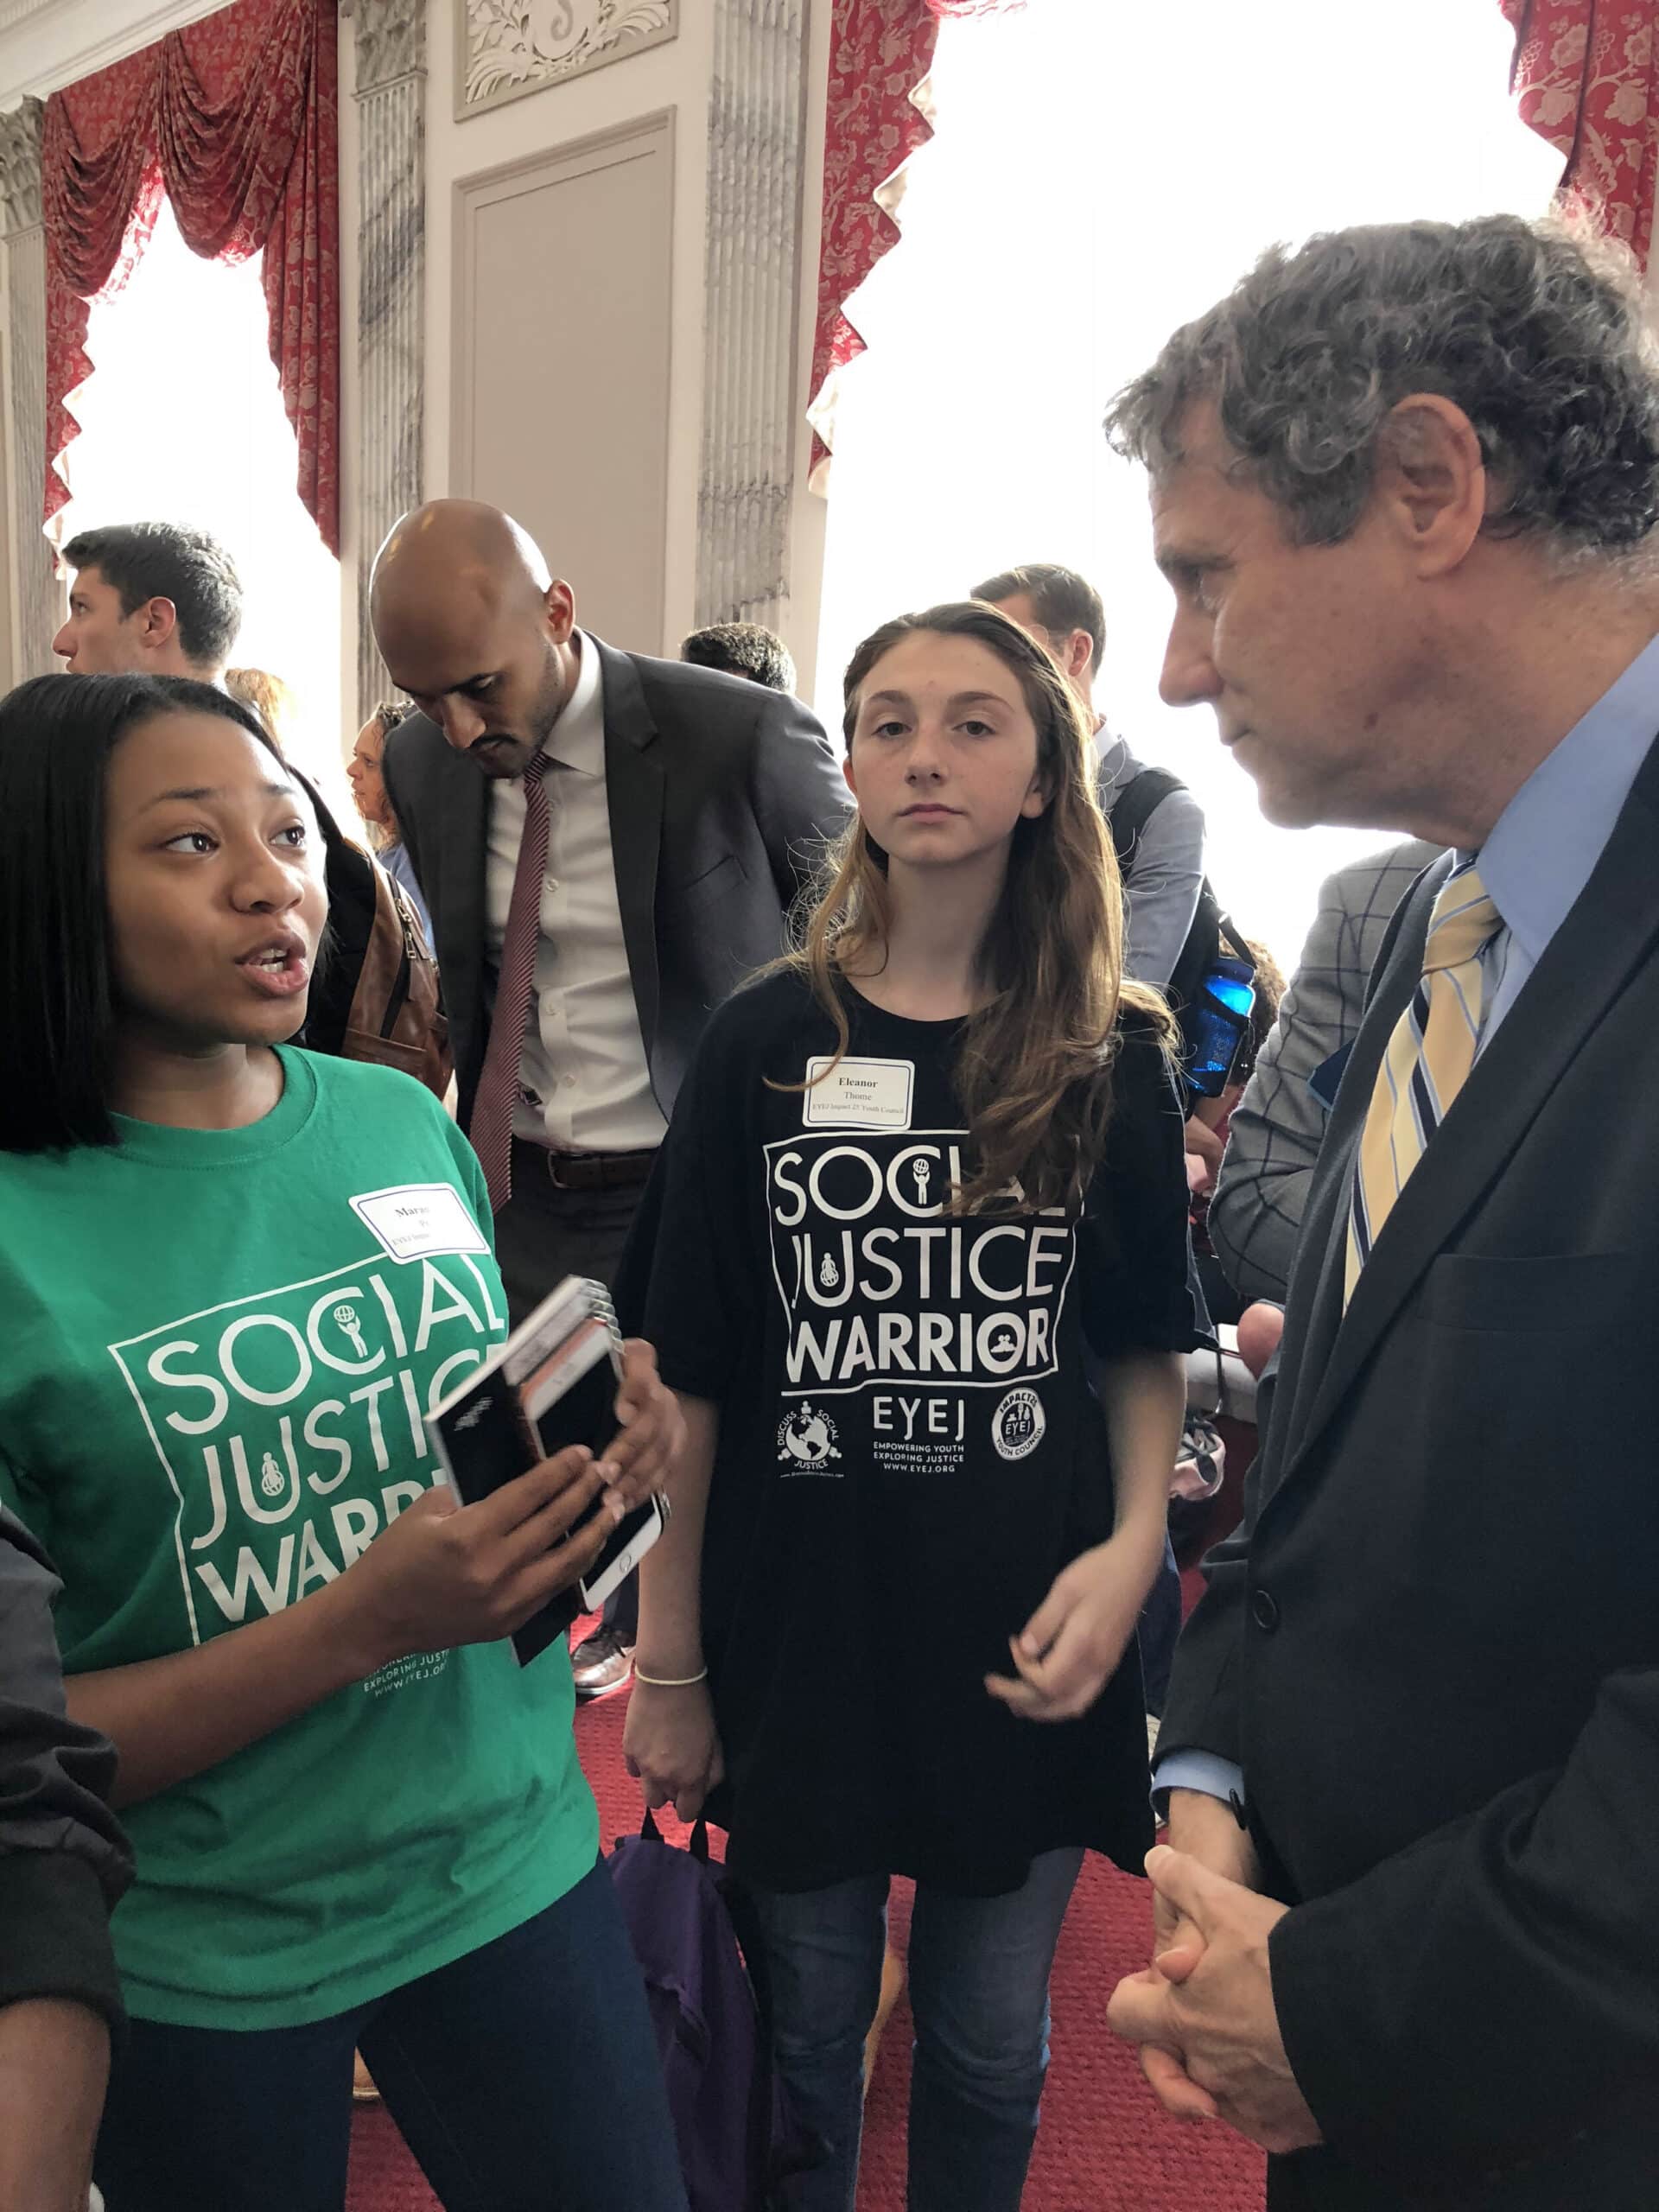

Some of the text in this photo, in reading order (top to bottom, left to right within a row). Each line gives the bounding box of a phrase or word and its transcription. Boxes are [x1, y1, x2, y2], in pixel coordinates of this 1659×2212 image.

[838, 1077, 878, 1088] Eleanor
[775, 1145, 1065, 1226] SOCI
[791, 1226, 1069, 1308] JUSTICE
[148, 1254, 505, 1434] SOCIAL
[786, 1307, 1050, 1382] WARRIOR
[778, 1410, 797, 1446] DISCUSS
[816, 1408, 840, 1441] SOCIAL
[874, 1396, 965, 1442] EYEJ
[873, 1440, 964, 1453] EMPOWERING YOUTH
[1015, 1425, 1043, 1456] COUNCIL
[794, 1459, 829, 1471] JUSTICE
[873, 1452, 964, 1463] EXPLORING JUSTICE
[883, 1462, 956, 1474] WWW.EYEJ.ORG
